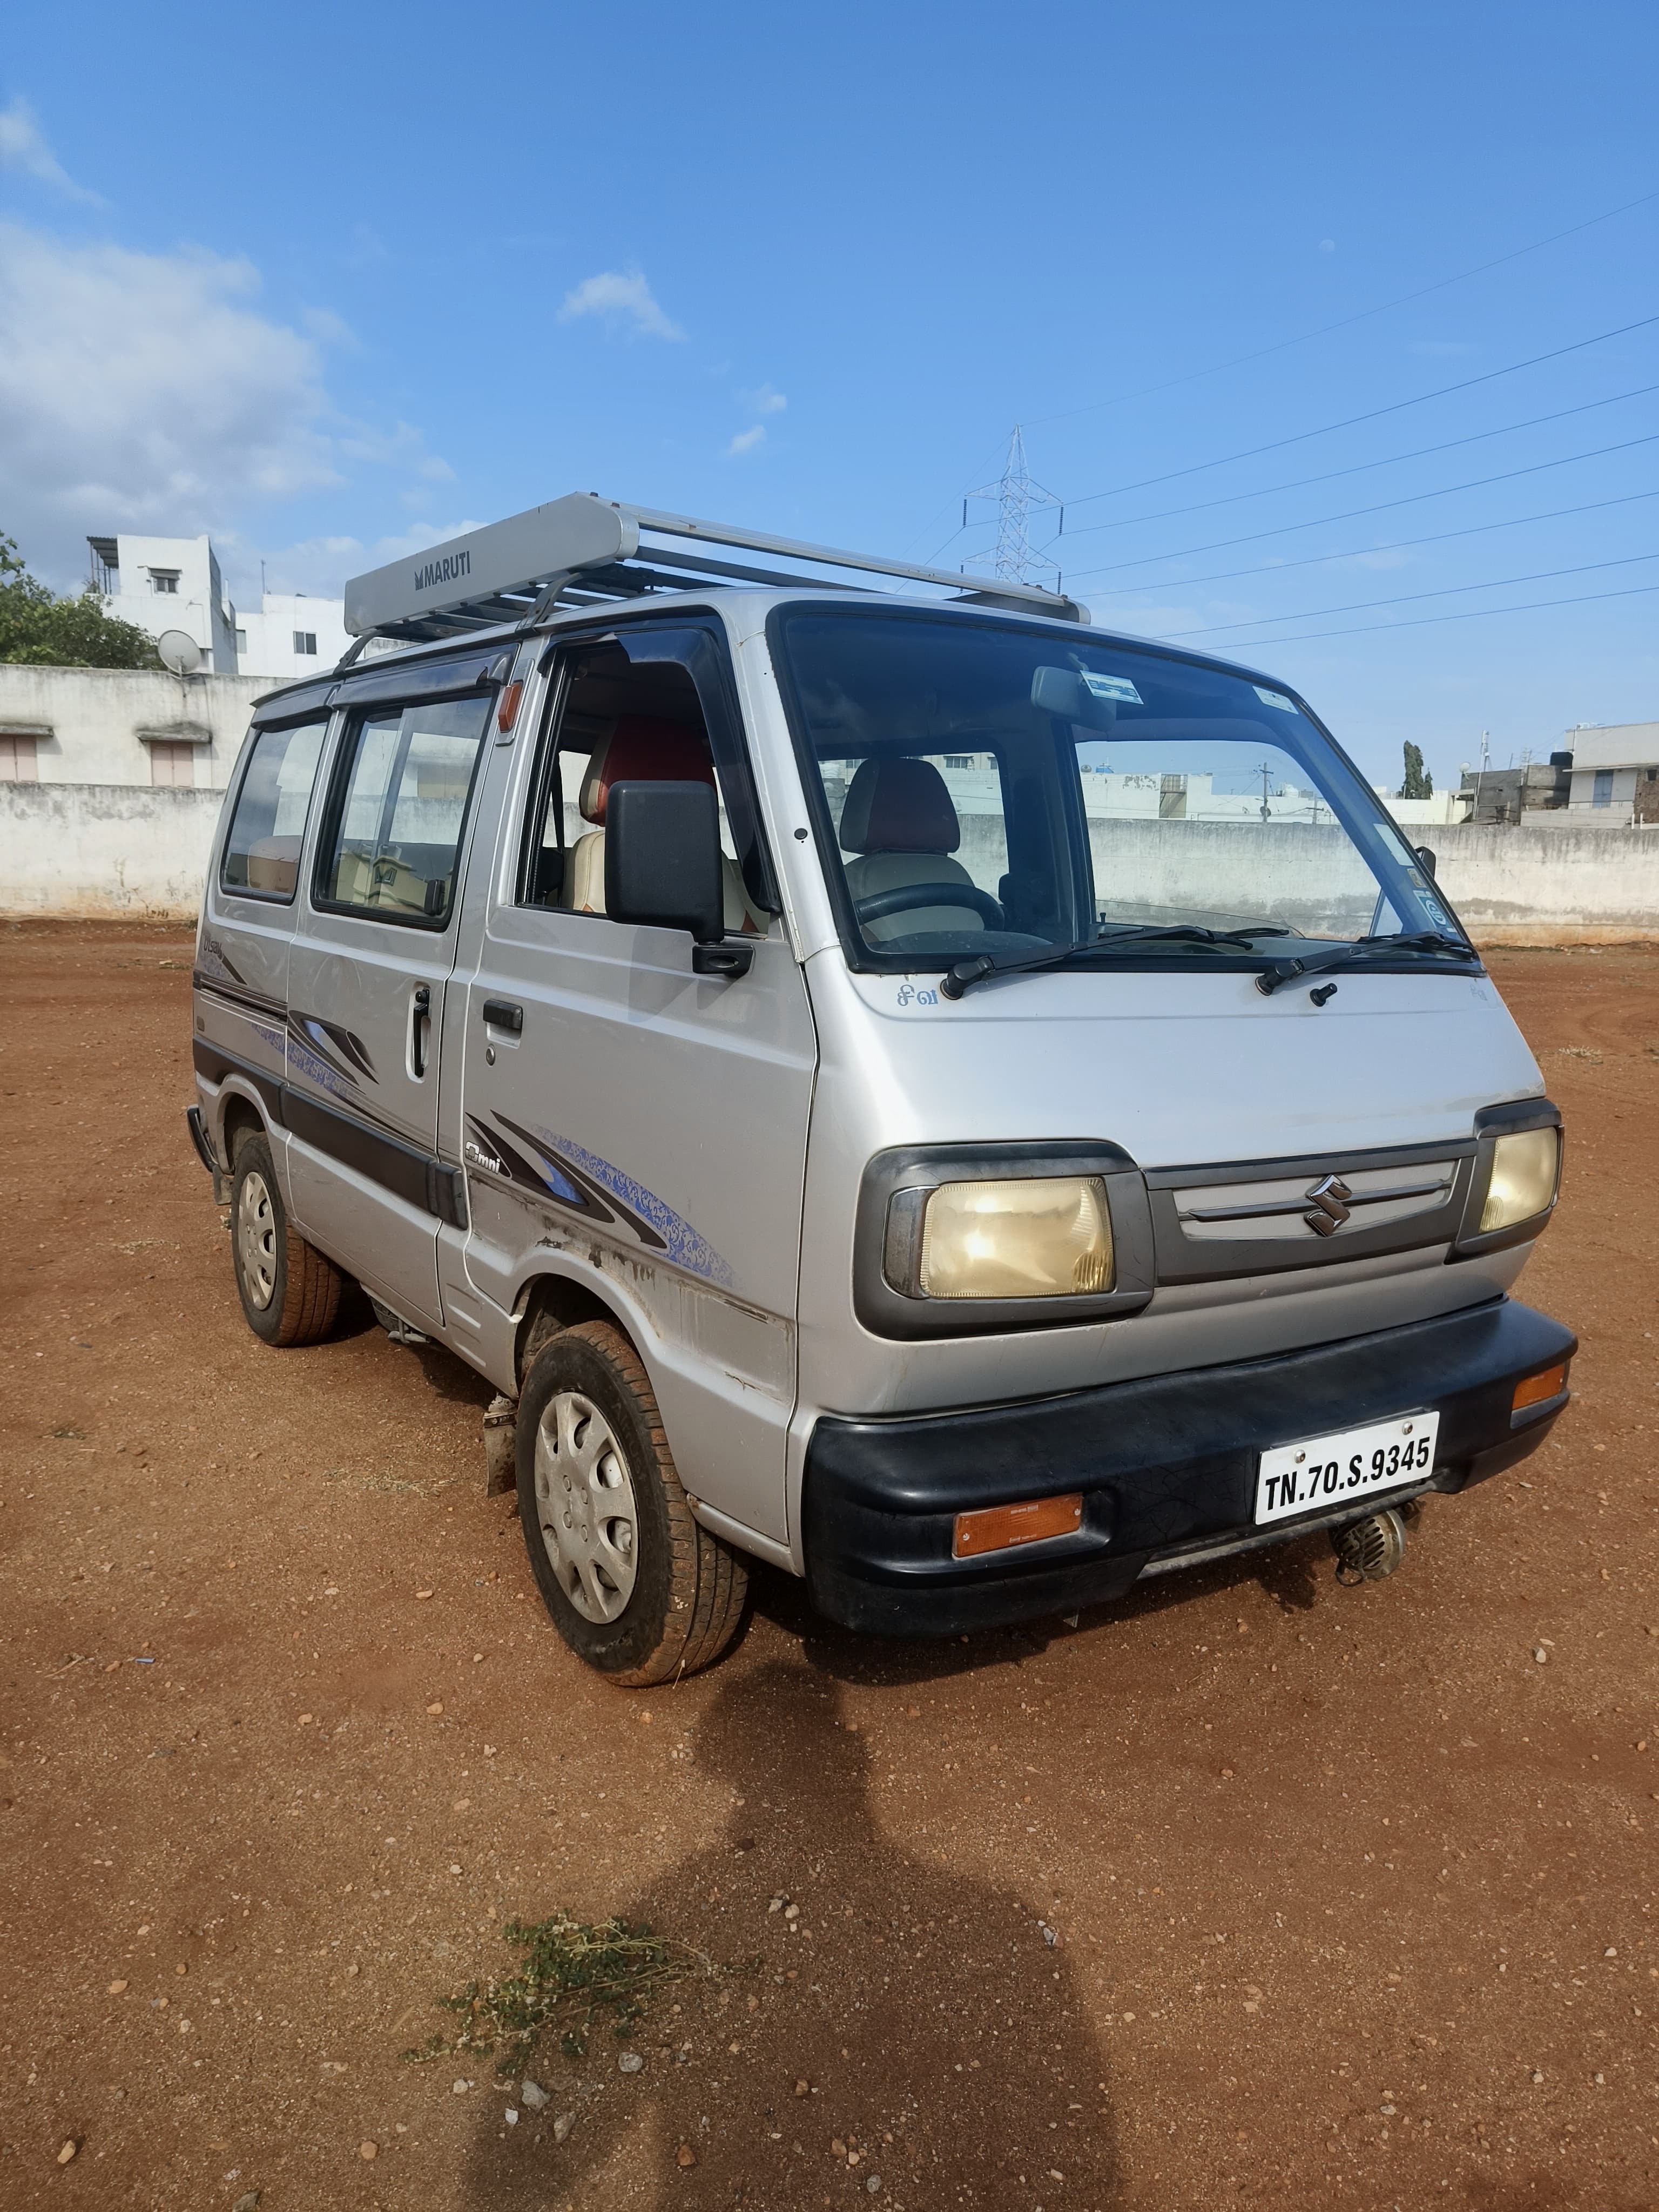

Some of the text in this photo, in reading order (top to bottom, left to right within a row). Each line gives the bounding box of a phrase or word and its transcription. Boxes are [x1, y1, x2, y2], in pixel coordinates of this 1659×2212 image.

[424, 551, 470, 588] MARUTI
[466, 1141, 501, 1175] Omni
[1265, 1437, 1431, 1510] TN.70.S.9345
